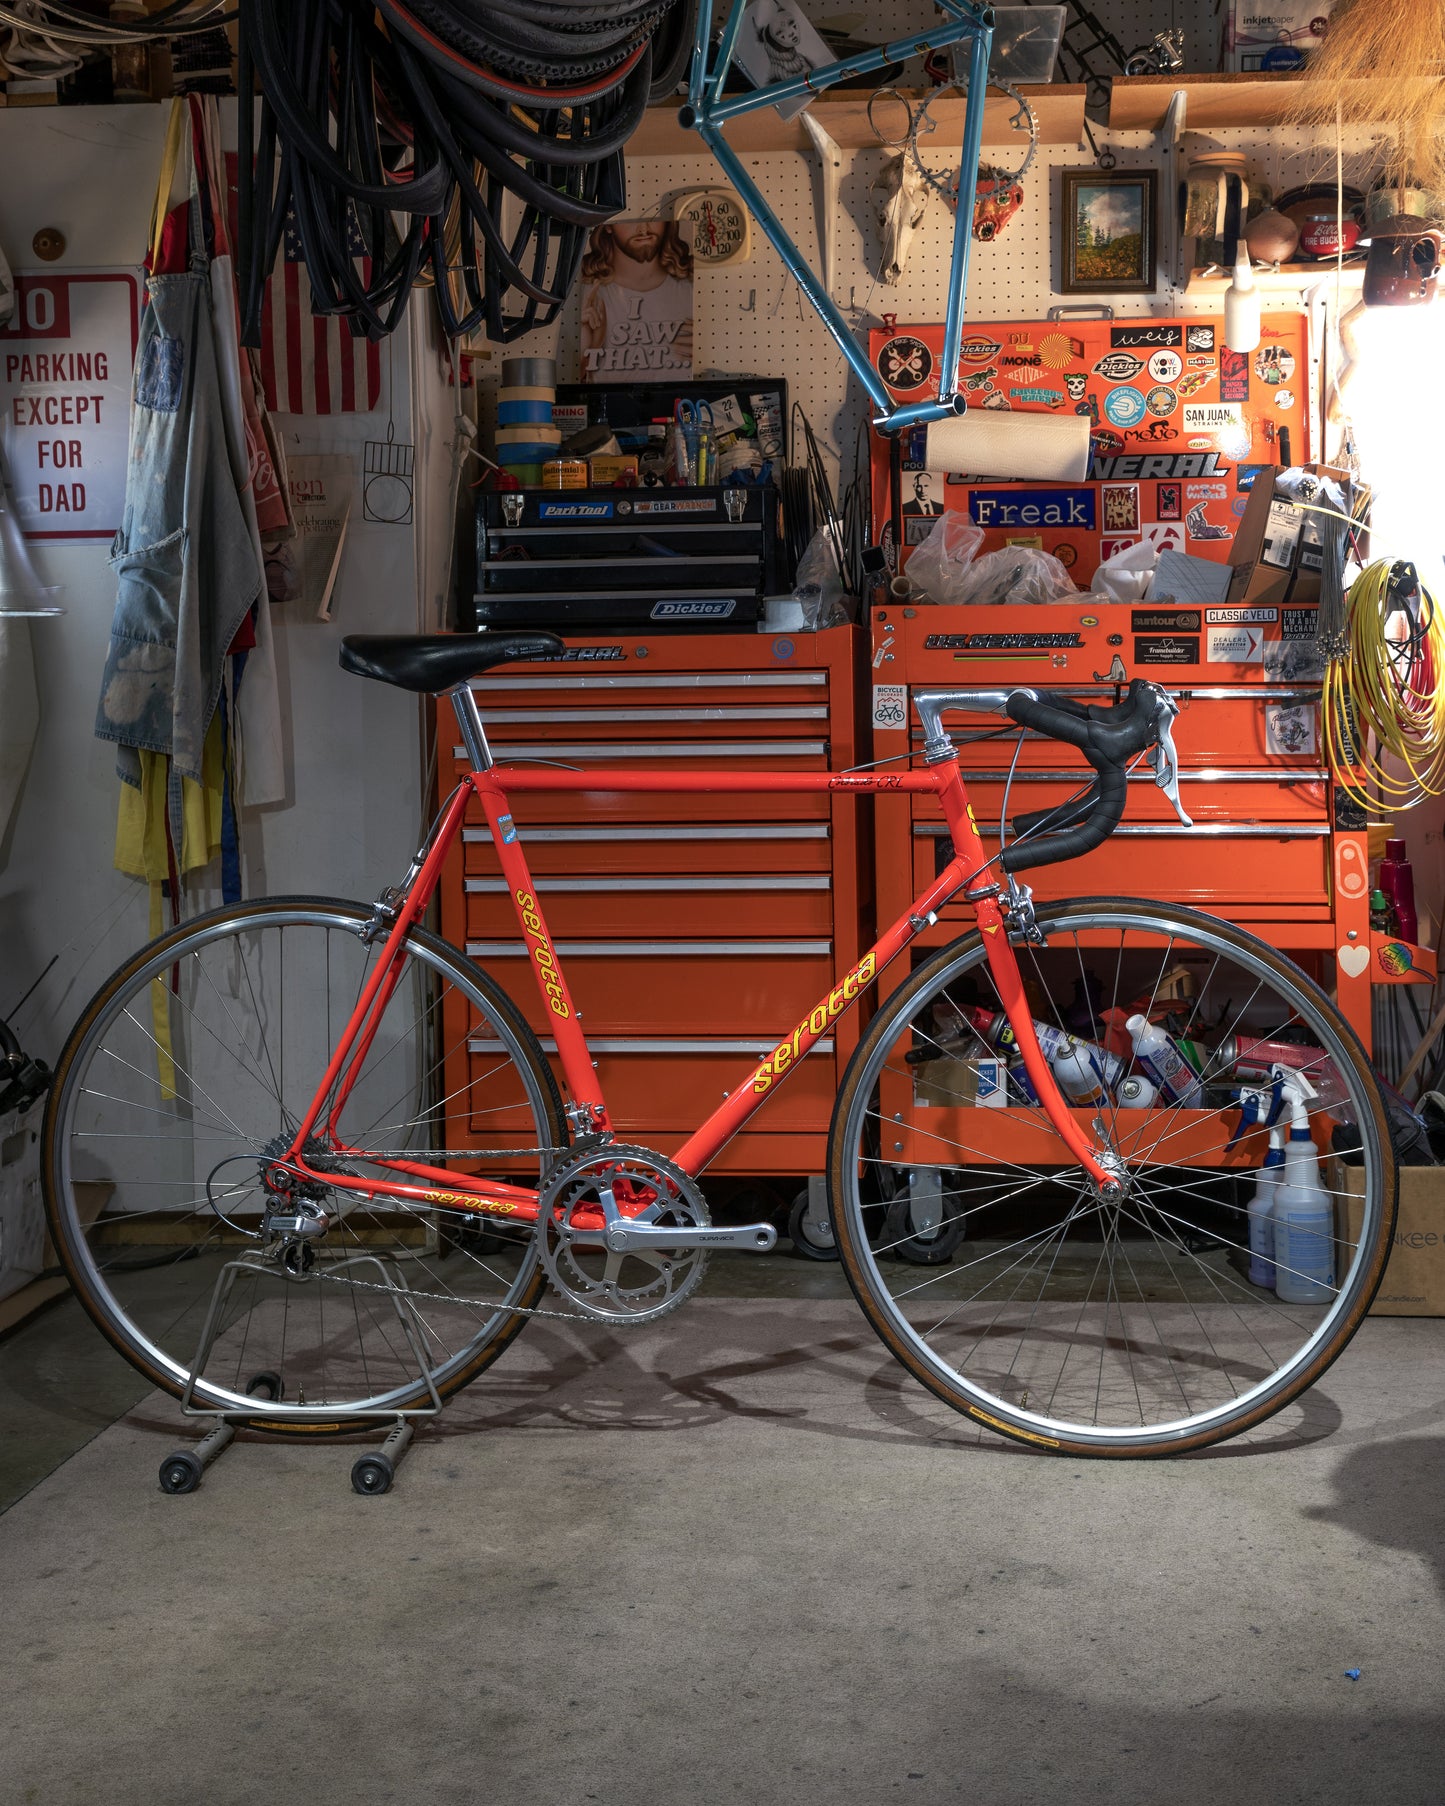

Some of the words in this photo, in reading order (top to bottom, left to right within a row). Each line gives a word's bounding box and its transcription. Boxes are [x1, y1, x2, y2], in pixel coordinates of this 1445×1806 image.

[700, 200, 713, 212] 40
[717, 203, 730, 215] 60
[688, 210, 700, 222] 20
[727, 215, 739, 227] 80
[726, 229, 740, 241] 100
[1319, 235, 1347, 245] BUCKT
[716, 242, 731, 255] 120
[626, 296, 644, 321] I
[609, 320, 687, 345] SAW
[958, 344, 997, 354] Dickies
[6, 352, 109, 383] PARKING
[1098, 361, 1141, 371] Dickies
[1007, 366, 1046, 384] REVIVAL
[12, 396, 105, 426] EXCEPT
[722, 399, 734, 412] 22
[552, 408, 585, 416] RNING
[1185, 409, 1205, 421] SAN
[1207, 409, 1231, 421] JUAN
[37, 439, 83, 469] FOR
[1085, 452, 1231, 480] NERAL
[38, 482, 87, 513] DAD
[544, 505, 577, 516] Park
[576, 504, 609, 515] Tool
[976, 497, 1088, 524] Freak
[1160, 511, 1180, 519] CHROME
[659, 603, 723, 614] Dickies
[1133, 616, 1177, 626] suntour
[1209, 610, 1249, 621] CLASSIC
[1251, 610, 1274, 621] VELO
[516, 888, 570, 1019] serotta
[753, 951, 877, 1093] serotta
[424, 1190, 519, 1213] serotta
